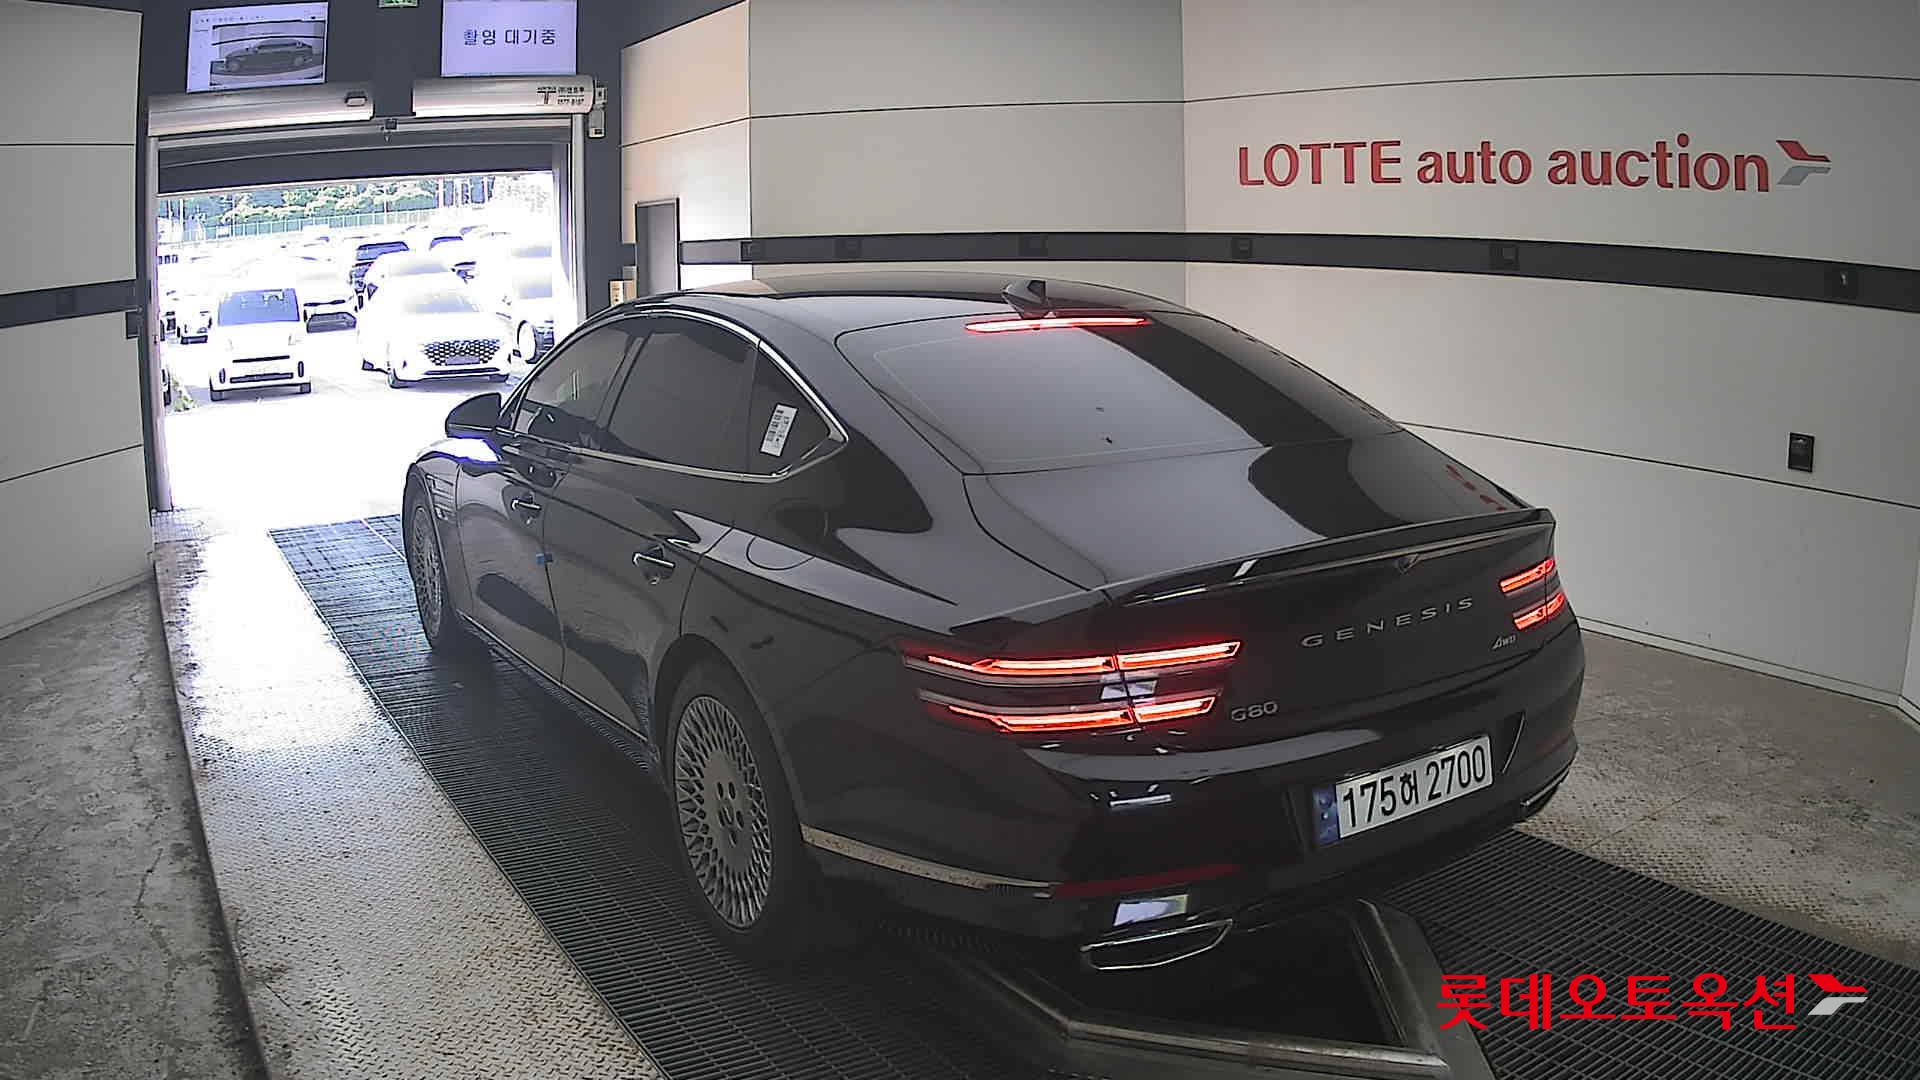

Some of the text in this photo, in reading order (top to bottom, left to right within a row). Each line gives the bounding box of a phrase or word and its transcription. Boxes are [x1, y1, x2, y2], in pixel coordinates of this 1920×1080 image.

[504, 29, 556, 45] 대기중
[1238, 134, 1770, 192] LOTTE auto auction
[1301, 597, 1473, 648] GENESIS
[1491, 633, 1517, 651] AWD
[1230, 700, 1279, 722] G80
[1343, 744, 1486, 828] 175허 2700
